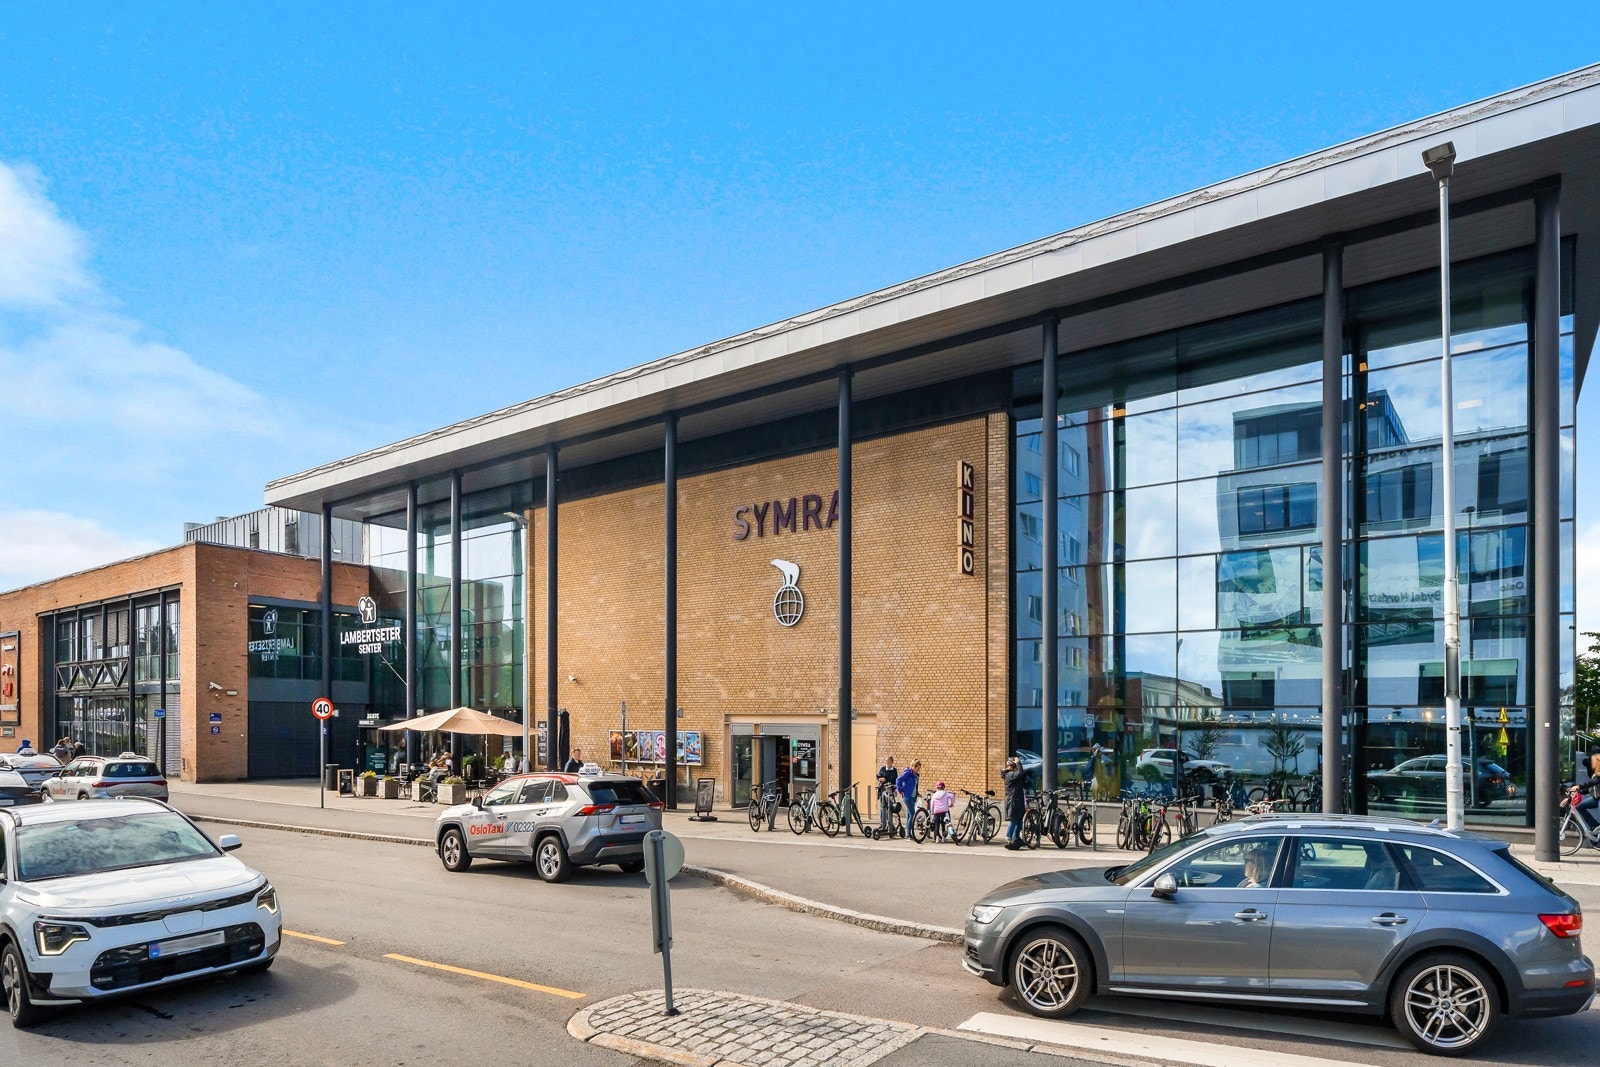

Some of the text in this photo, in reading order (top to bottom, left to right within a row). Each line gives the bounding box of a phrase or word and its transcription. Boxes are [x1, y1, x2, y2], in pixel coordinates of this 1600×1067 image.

[732, 490, 839, 541] SYMRA
[962, 464, 974, 574] KINO
[340, 627, 401, 645] LAMBERTSETER
[358, 643, 382, 654] SENTER
[316, 703, 330, 714] 40
[469, 822, 535, 836] OsloTaxi 02323
